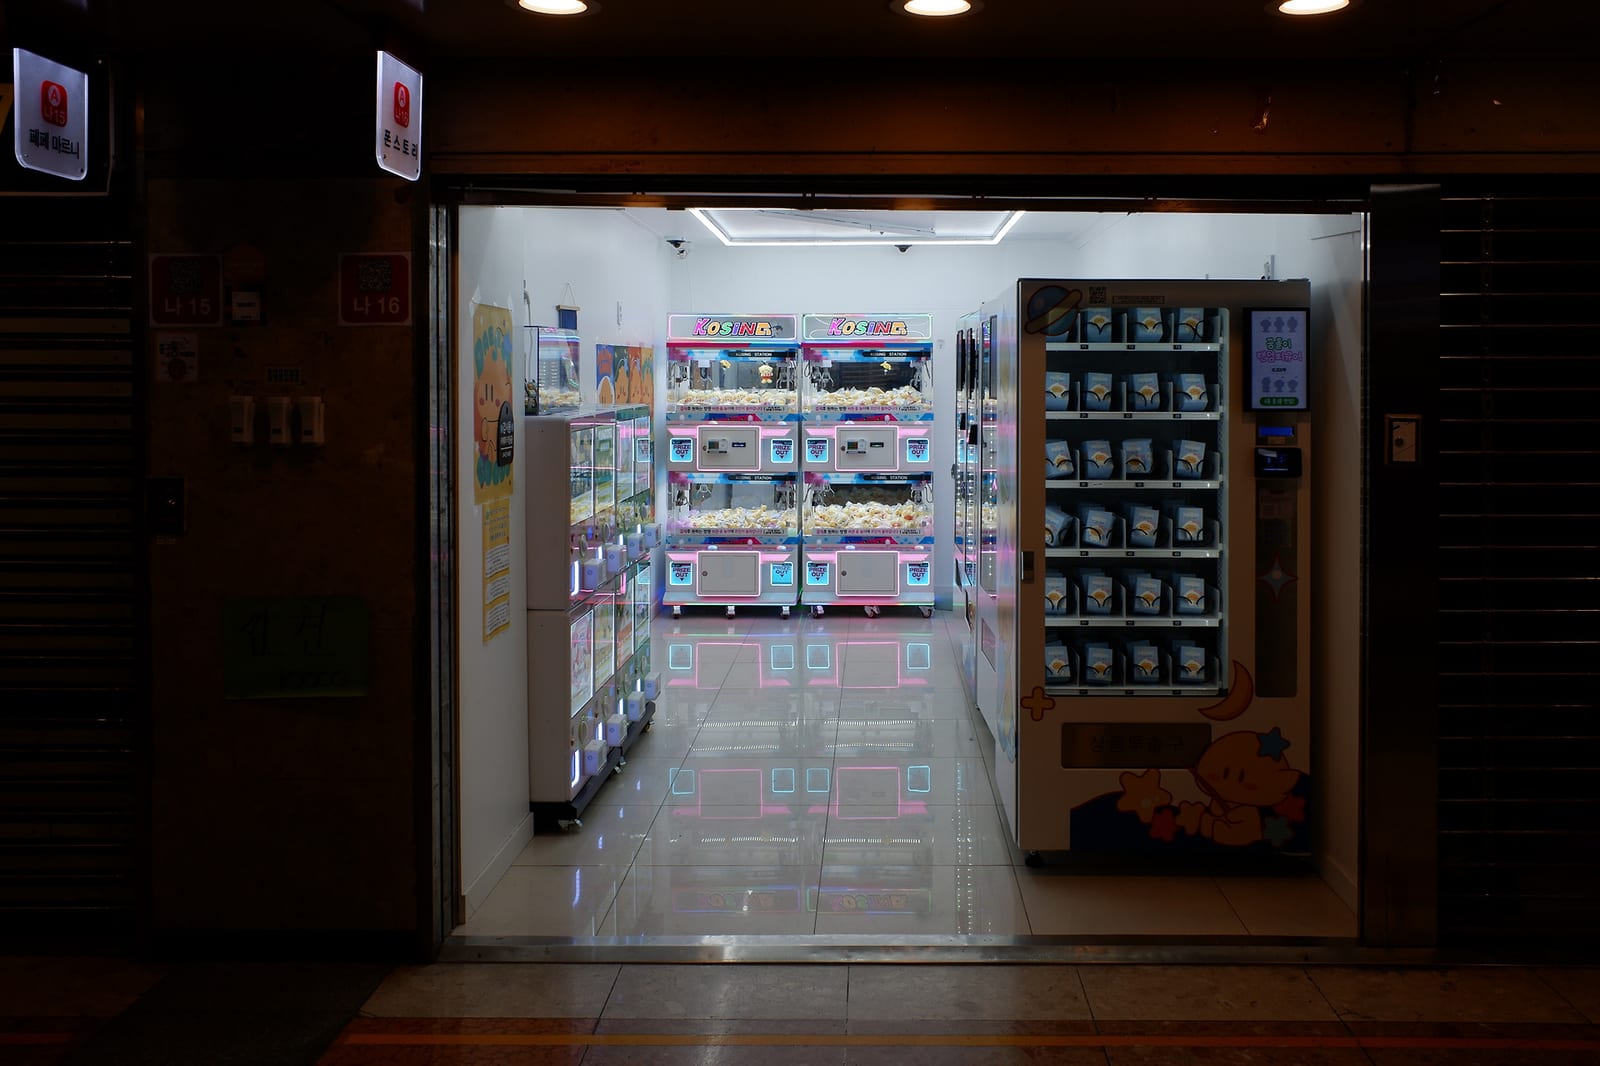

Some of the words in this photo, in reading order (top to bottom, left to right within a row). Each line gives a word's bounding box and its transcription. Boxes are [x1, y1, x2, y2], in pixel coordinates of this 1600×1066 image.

[52, 135, 79, 160] 마르니
[164, 296, 183, 317] 나
[189, 298, 211, 316] 15
[353, 296, 370, 317] 나
[376, 297, 400, 315] 16
[693, 318, 773, 336] KOSING
[828, 318, 907, 336] KOSING
